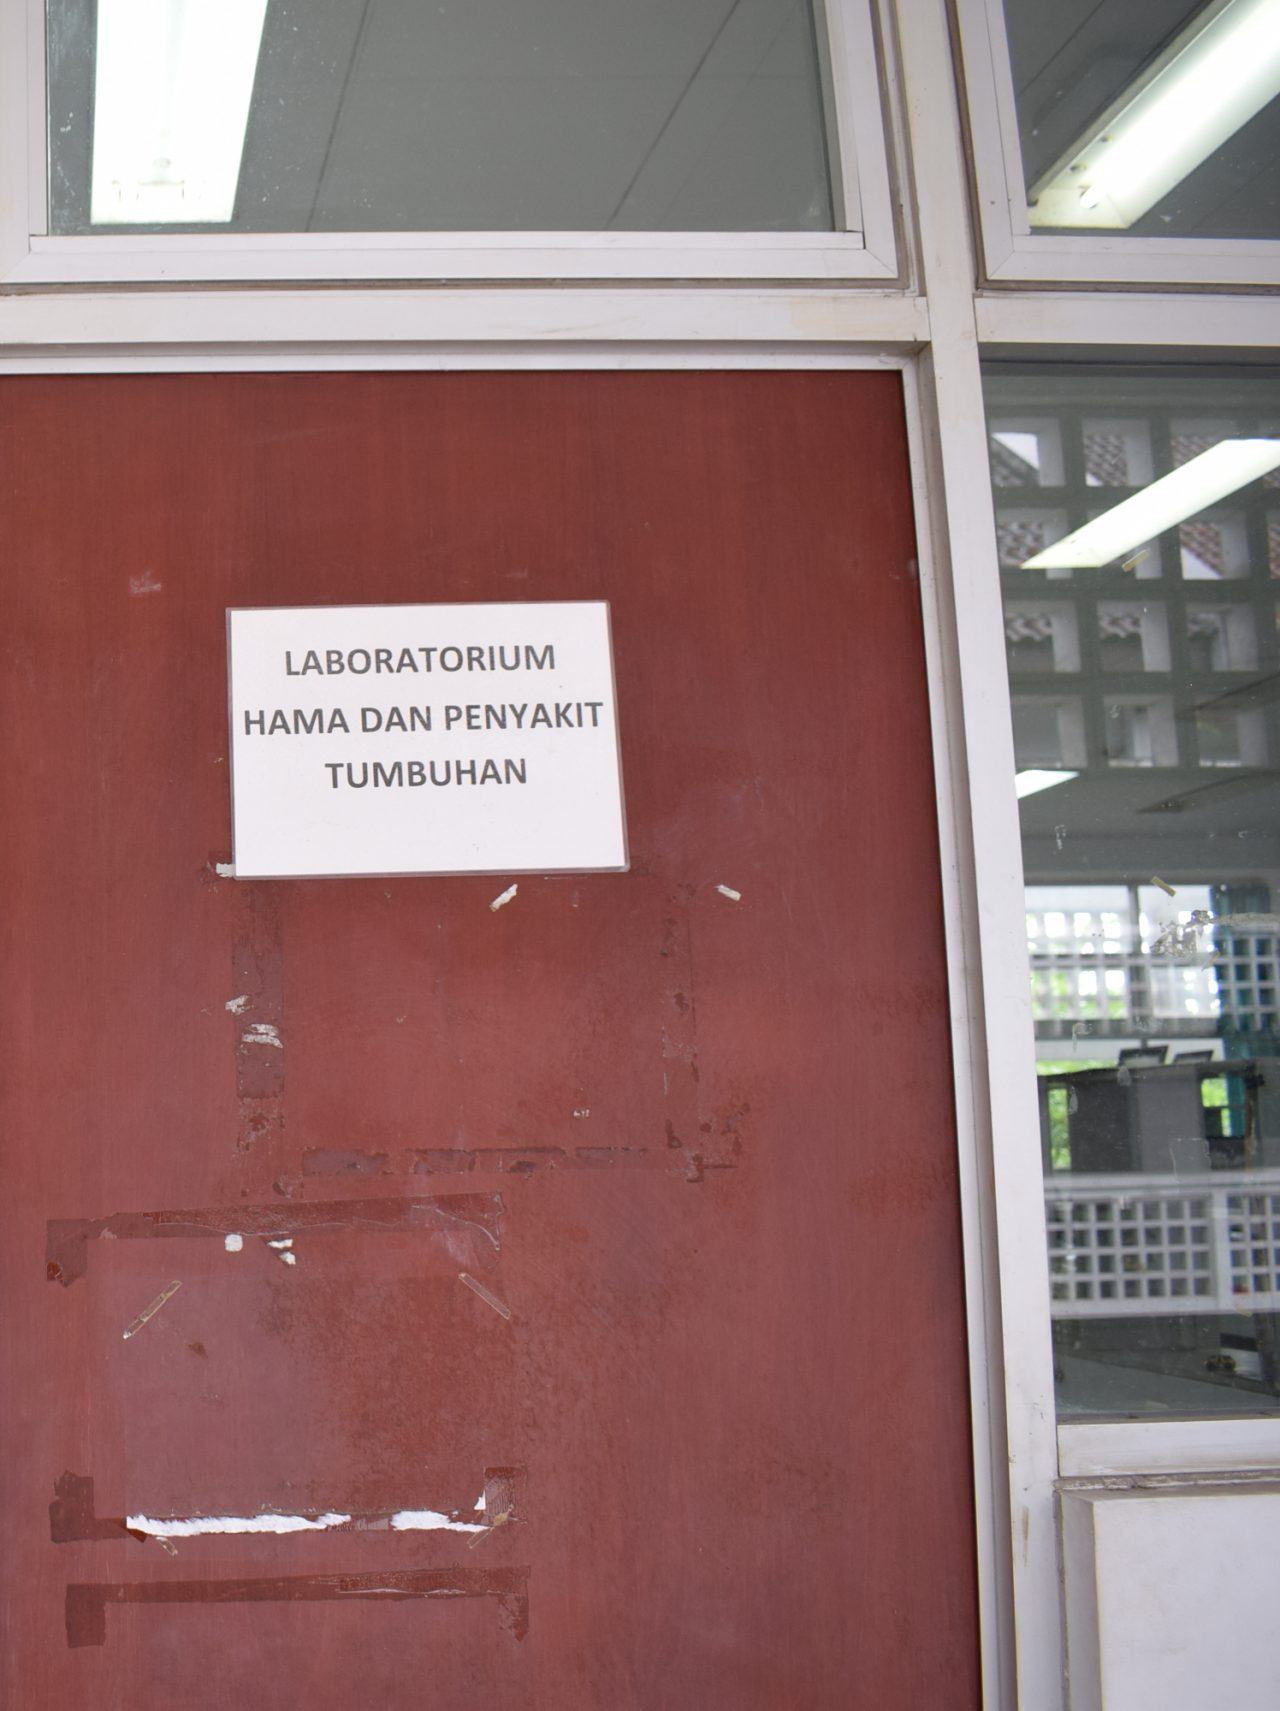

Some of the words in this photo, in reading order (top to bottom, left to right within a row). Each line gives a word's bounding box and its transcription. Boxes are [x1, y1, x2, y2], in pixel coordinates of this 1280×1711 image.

[285, 644, 555, 676] LABORATORIUM
[244, 707, 350, 736] HAMA
[360, 705, 432, 733] DAN
[444, 701, 604, 731] PENYAKIT
[324, 758, 527, 789] TUMBUHAN
